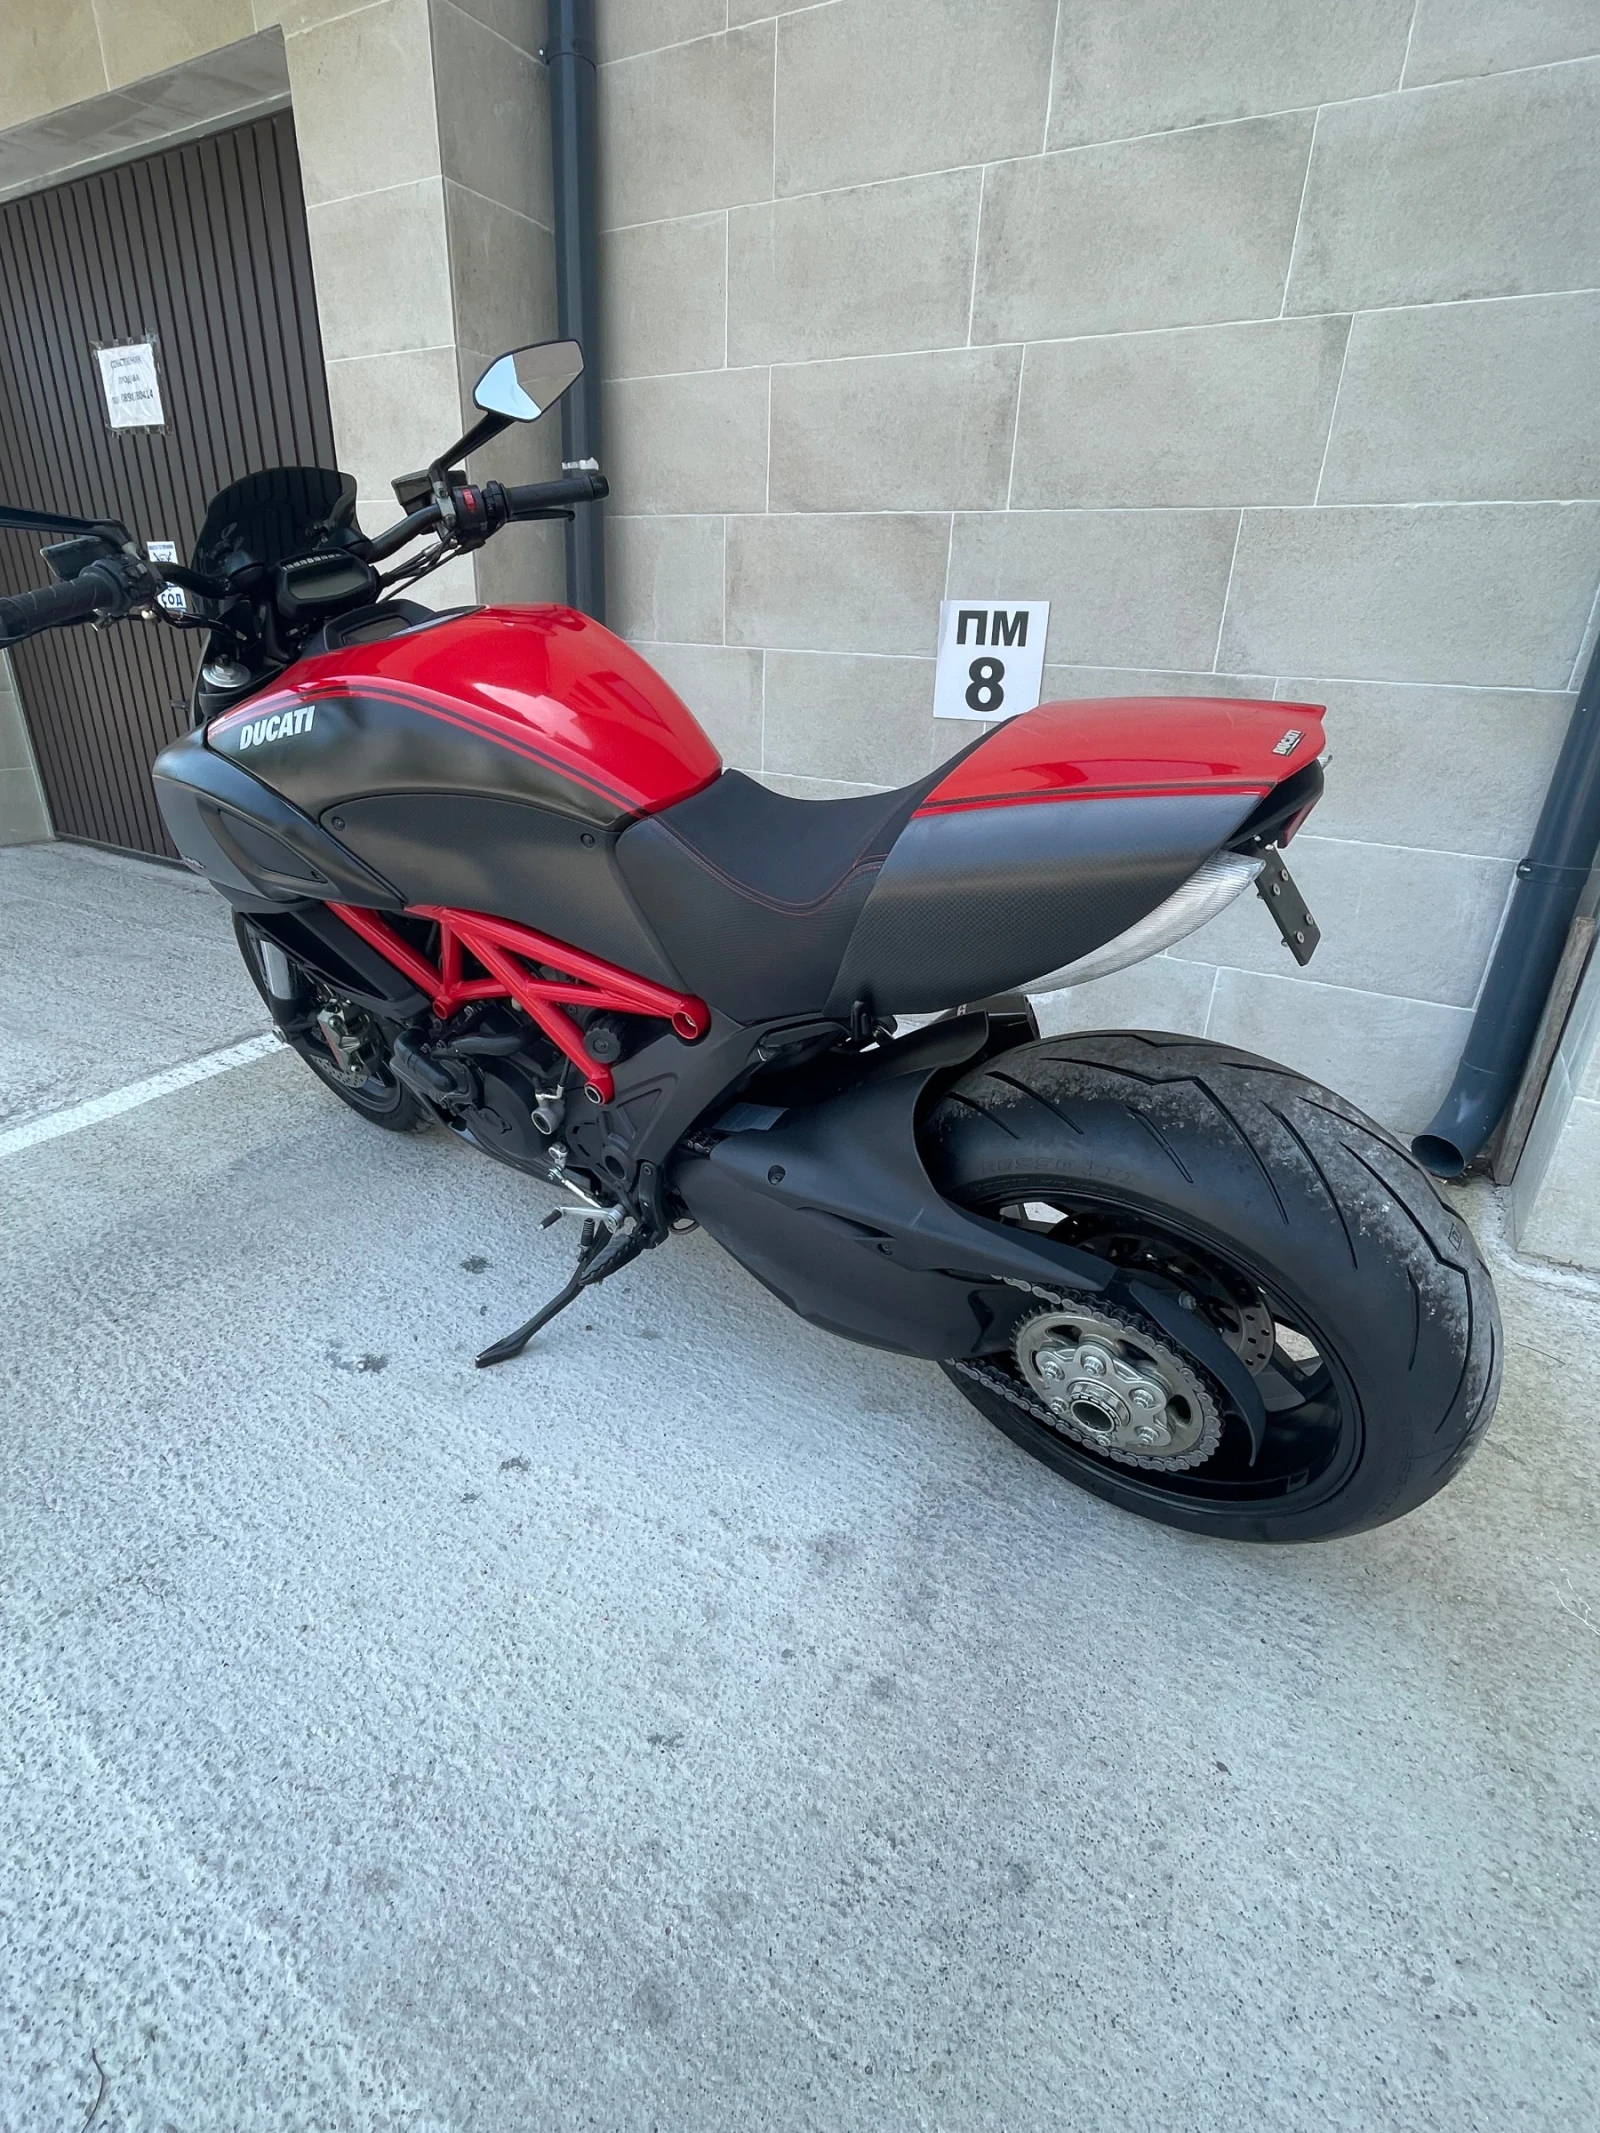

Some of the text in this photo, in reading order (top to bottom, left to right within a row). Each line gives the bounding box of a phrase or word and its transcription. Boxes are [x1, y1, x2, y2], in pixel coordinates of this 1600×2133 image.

[956, 610, 1029, 647] ПМ
[965, 657, 1005, 712] 8
[239, 705, 315, 750] DUCATI
[1272, 729, 1302, 755] DUCATI
[982, 1157, 1072, 1174] ROSSO
